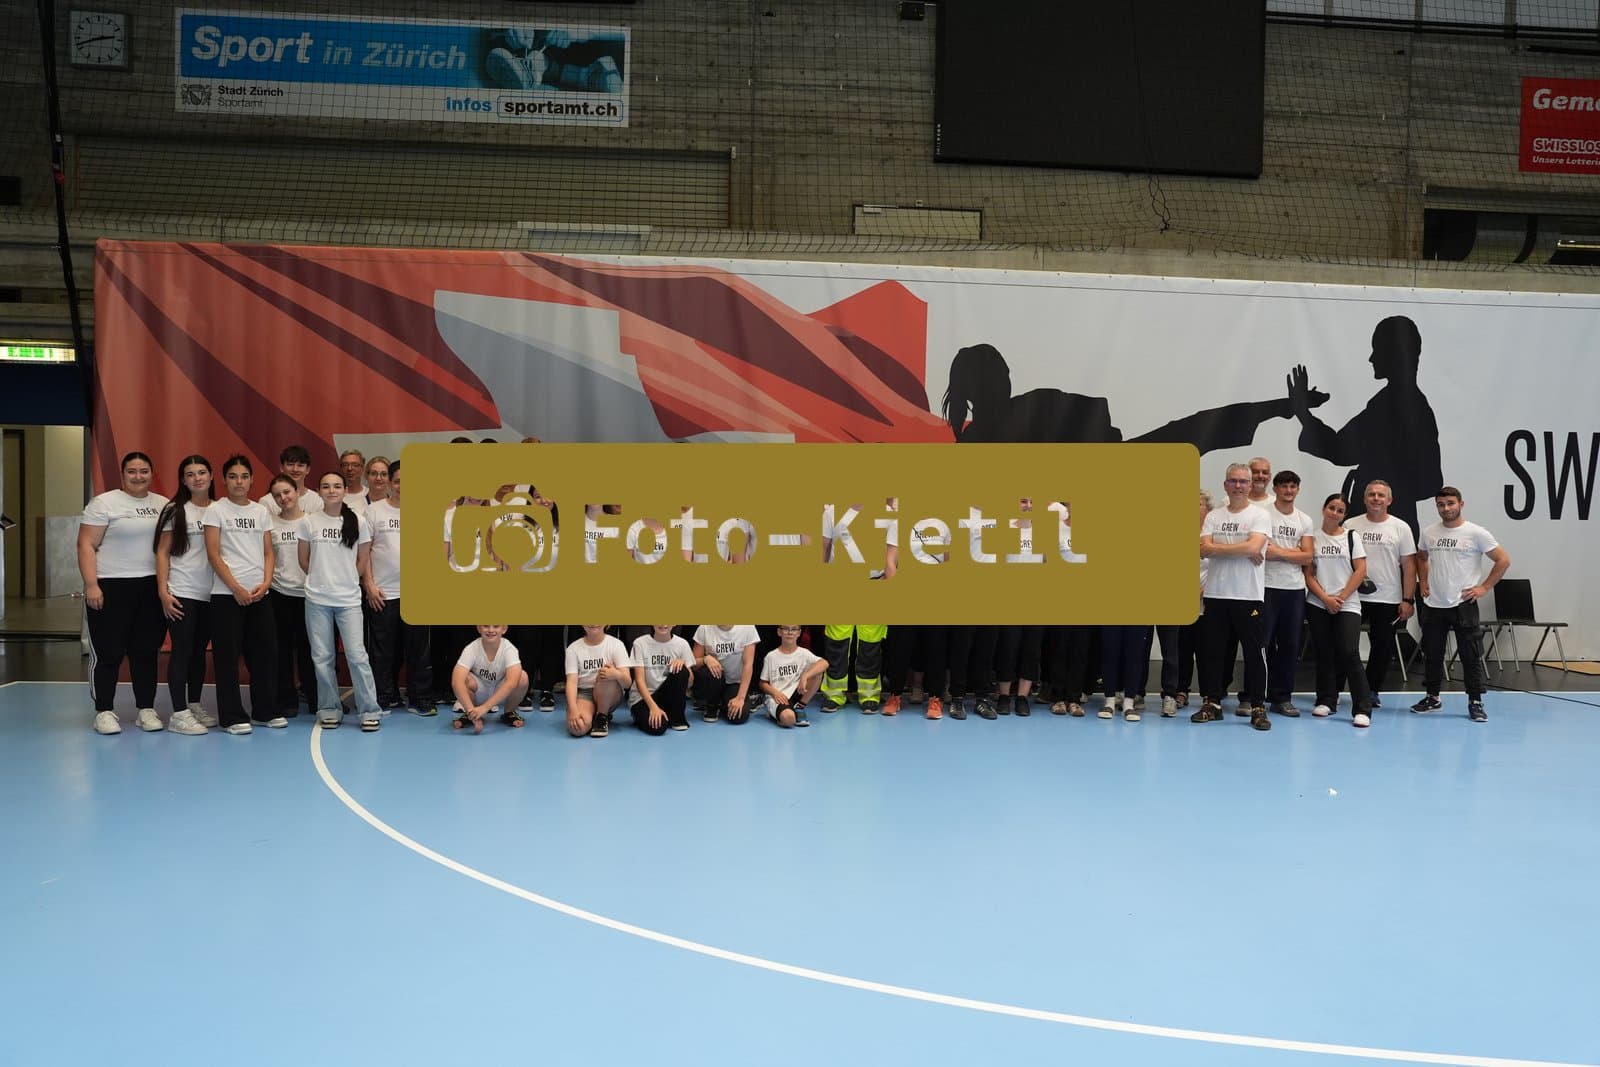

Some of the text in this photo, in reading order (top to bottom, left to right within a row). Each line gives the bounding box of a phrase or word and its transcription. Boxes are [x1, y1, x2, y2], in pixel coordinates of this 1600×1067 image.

[191, 25, 466, 70] Sport in Zürich
[218, 85, 284, 97] Stadt Zürich
[218, 96, 263, 108] Sportamt
[446, 97, 618, 118] infos sportamt.ch
[1532, 156, 1600, 166] Unsere Lotteri
[1504, 429, 1600, 520] SW
[234, 518, 255, 529] CREW
[389, 519, 400, 529] CR
[1222, 522, 1239, 532] CREW
[281, 531, 297, 541] CRE
[1279, 525, 1297, 537] CREW
[1363, 532, 1383, 541] CREW
[1437, 538, 1458, 548] CREW
[1321, 545, 1342, 555] CREW
[715, 642, 736, 654] CREW
[583, 658, 604, 670] CREW
[651, 655, 671, 666] CREW
[778, 664, 799, 677] CREW
